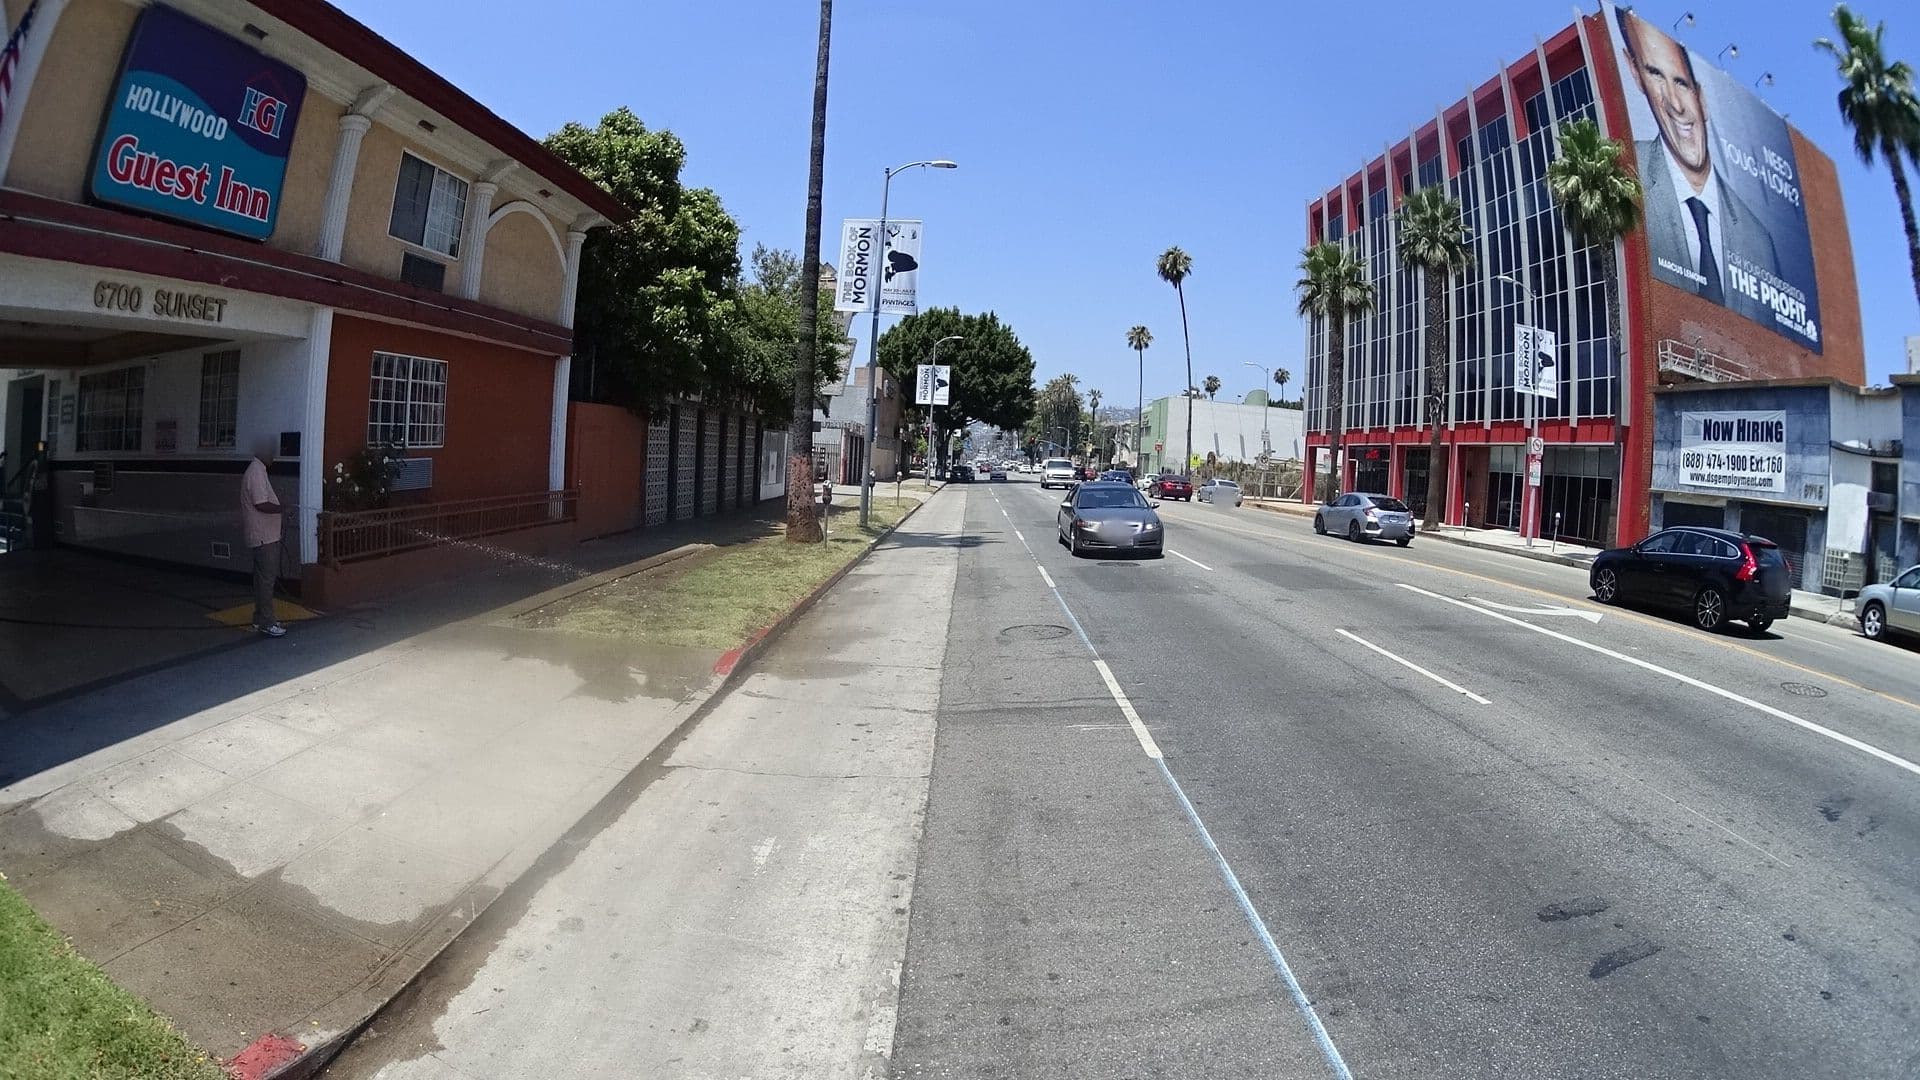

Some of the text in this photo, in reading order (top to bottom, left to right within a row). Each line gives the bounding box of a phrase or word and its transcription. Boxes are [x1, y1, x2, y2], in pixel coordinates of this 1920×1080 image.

[125, 84, 228, 141] HOLLYWOOD
[238, 86, 288, 139] HGI
[107, 133, 271, 223] Guest Inn
[1720, 138, 1767, 185] TOUGH
[1763, 145, 1793, 180] NEED
[842, 226, 859, 303] THE BOOK OF
[852, 227, 872, 304] MORMON
[93, 280, 228, 322] 6700 SUNSET
[882, 298, 915, 307] PANTAGES
[1728, 263, 1759, 301] THE
[1760, 280, 1807, 326] PROFIT
[1523, 331, 1531, 388] MORMON
[922, 368, 930, 401] MORMON
[1702, 418, 1784, 443] NOW HIRING
[1682, 451, 1704, 470] (888)
[1706, 453, 1746, 472] 474-1900
[1689, 471, 1774, 488] www.dsgemployment.com
